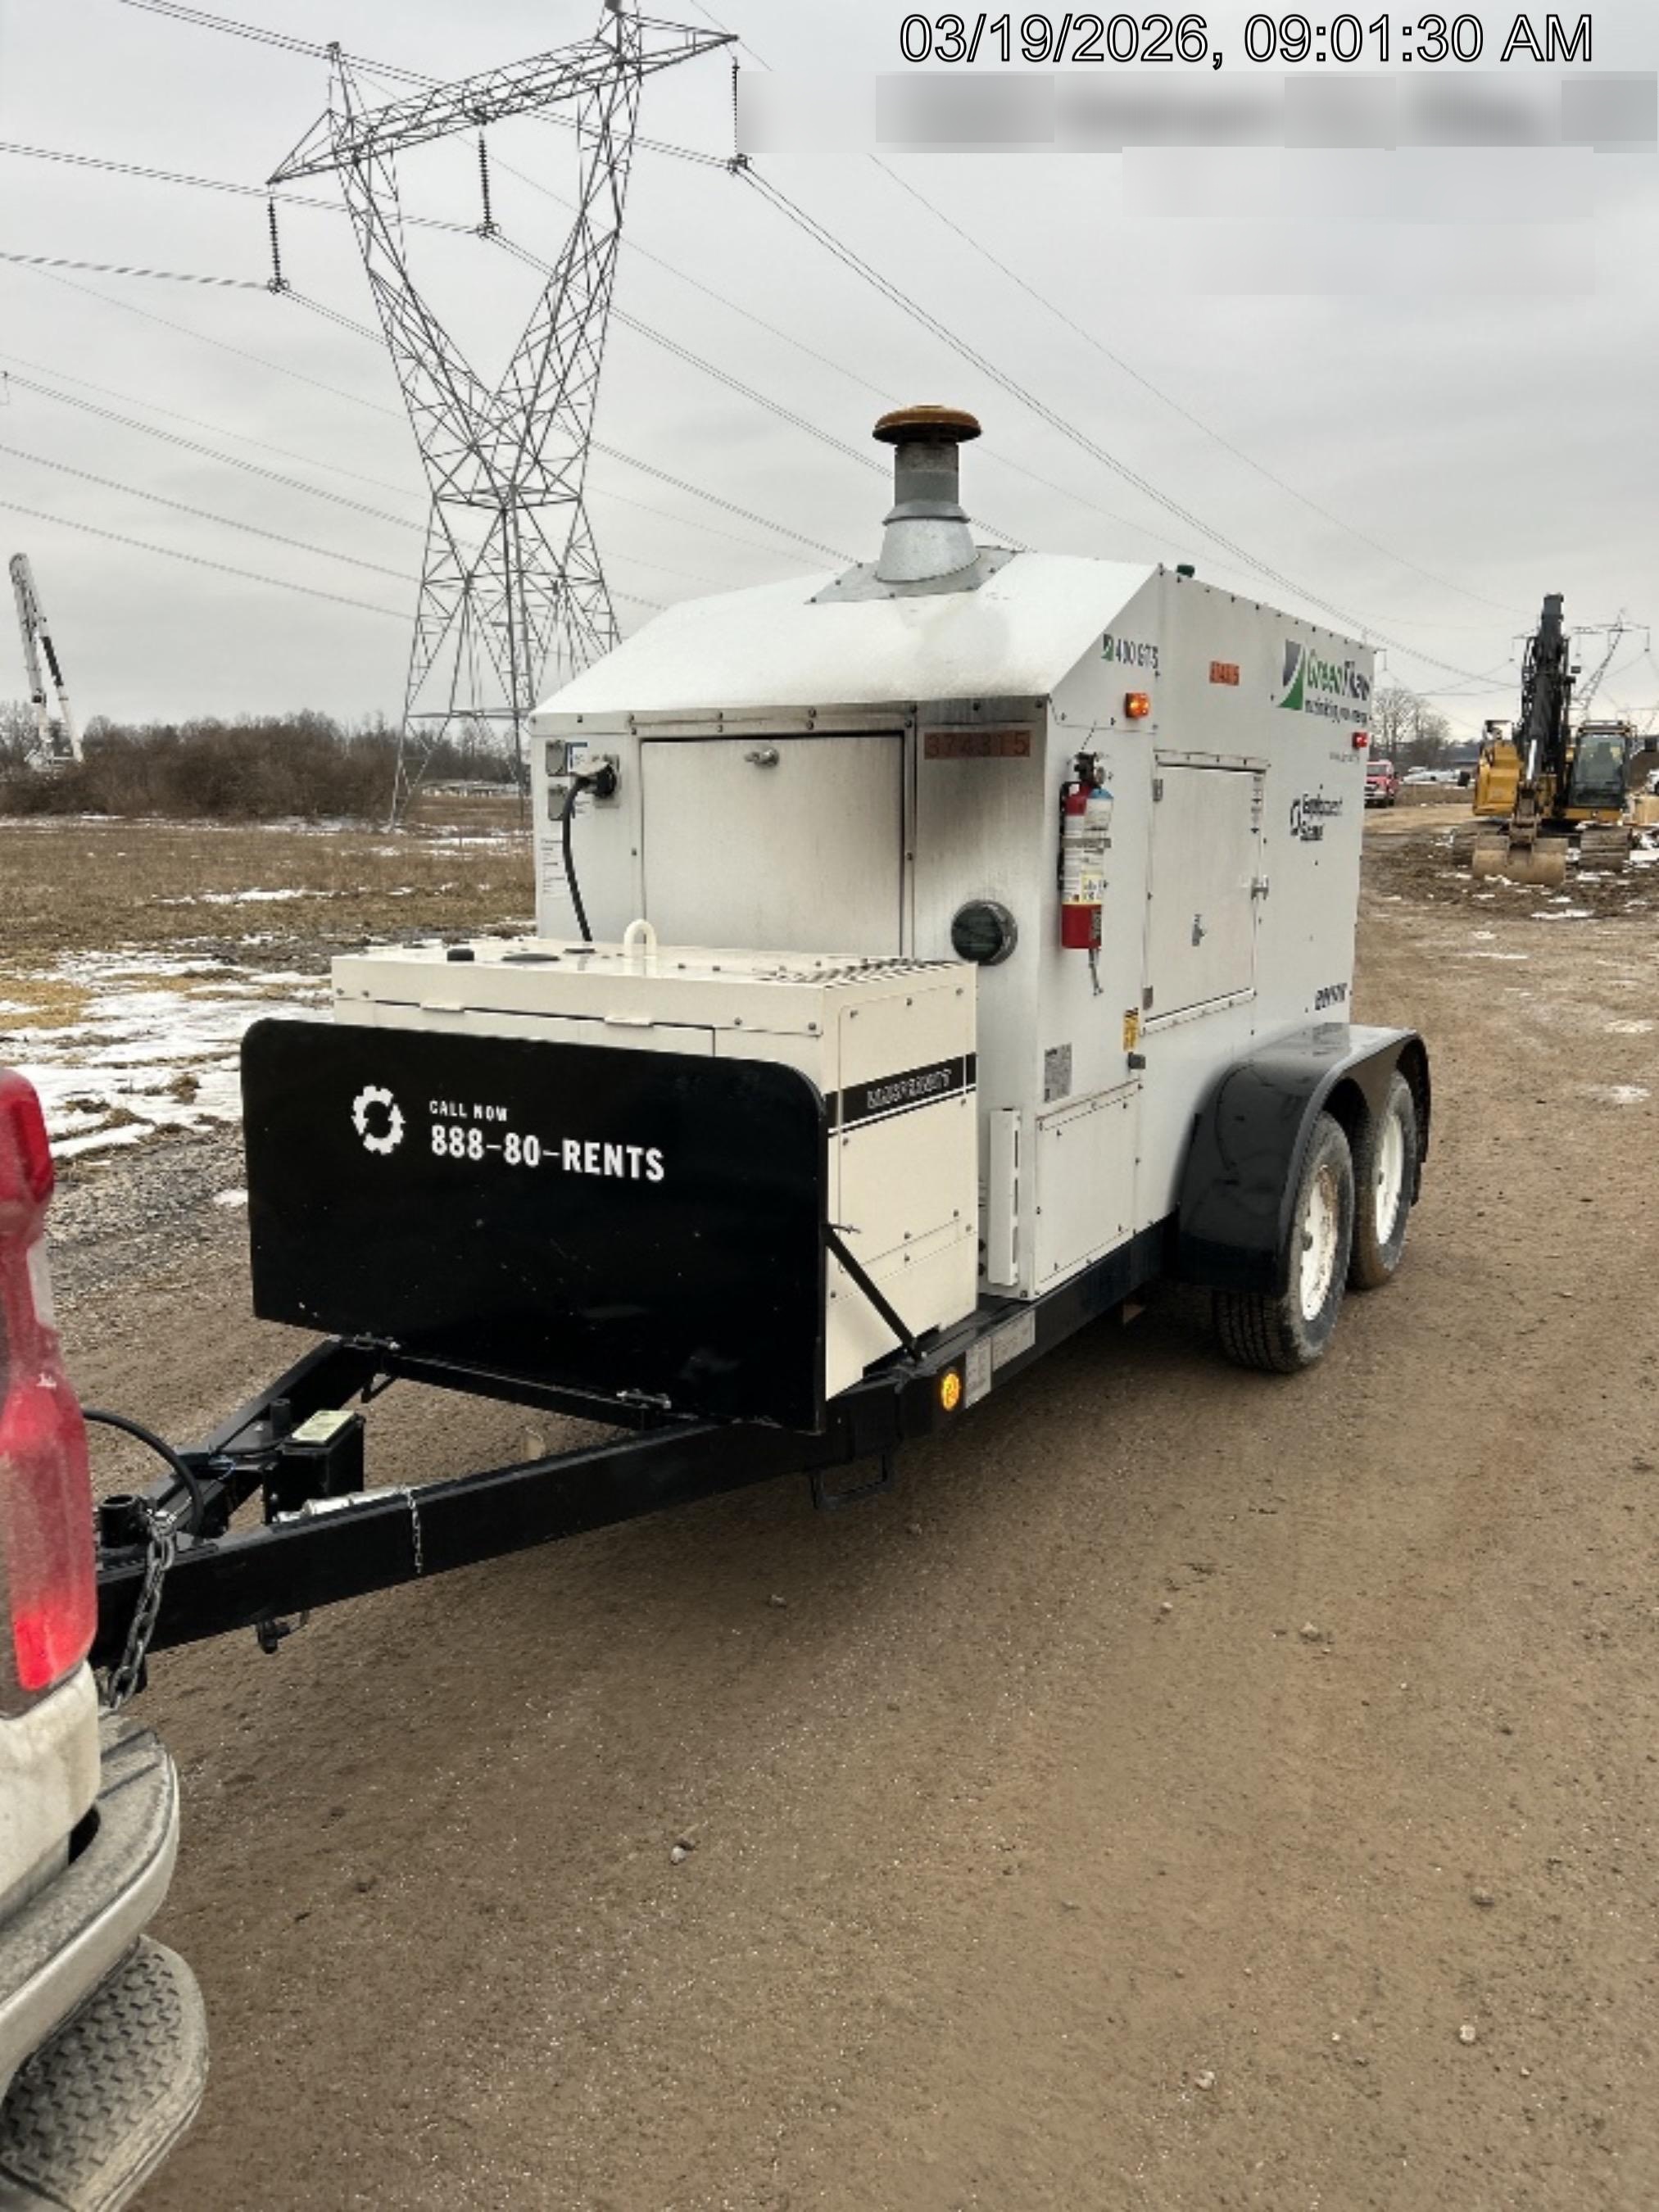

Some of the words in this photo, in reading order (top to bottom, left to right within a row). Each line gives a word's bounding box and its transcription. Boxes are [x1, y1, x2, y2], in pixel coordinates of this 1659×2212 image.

[429, 1100, 468, 1119] CALL
[474, 1105, 508, 1122] NOW
[431, 1123, 664, 1181] 888-80-RENTS
